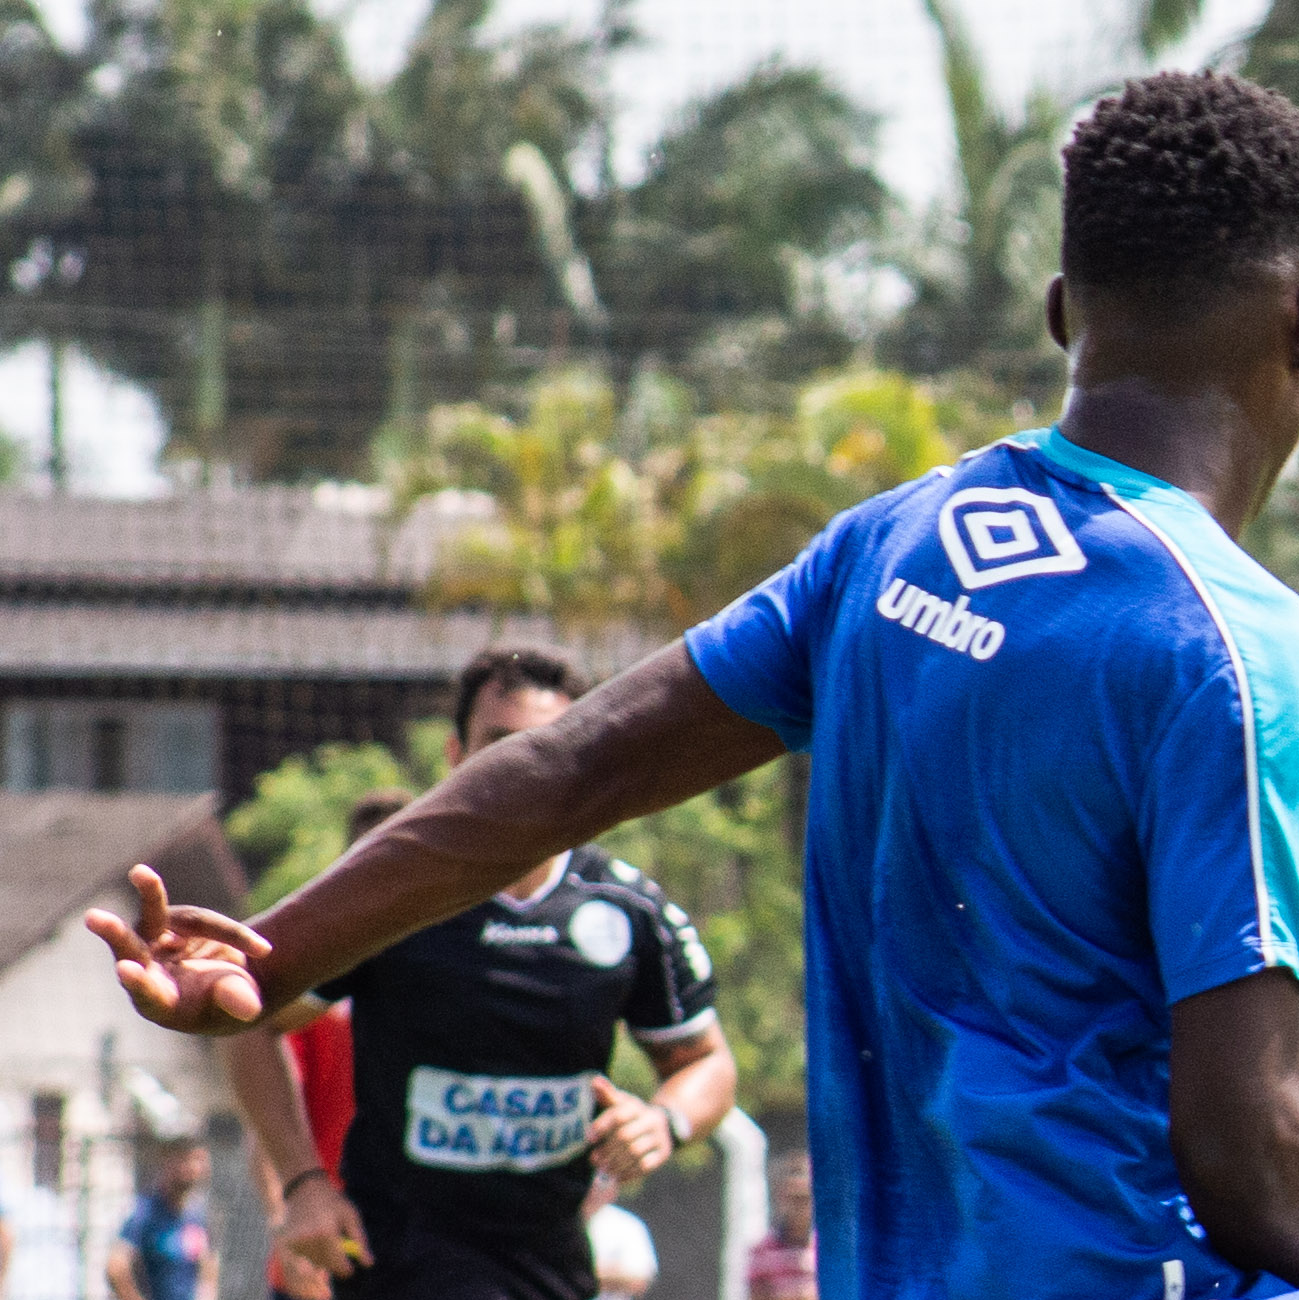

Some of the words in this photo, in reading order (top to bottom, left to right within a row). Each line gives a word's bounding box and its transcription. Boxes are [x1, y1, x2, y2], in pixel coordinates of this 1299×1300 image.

[877, 577, 1005, 660] umbro
[443, 1083, 582, 1118] CASAS
[418, 1116, 477, 1156] DA
